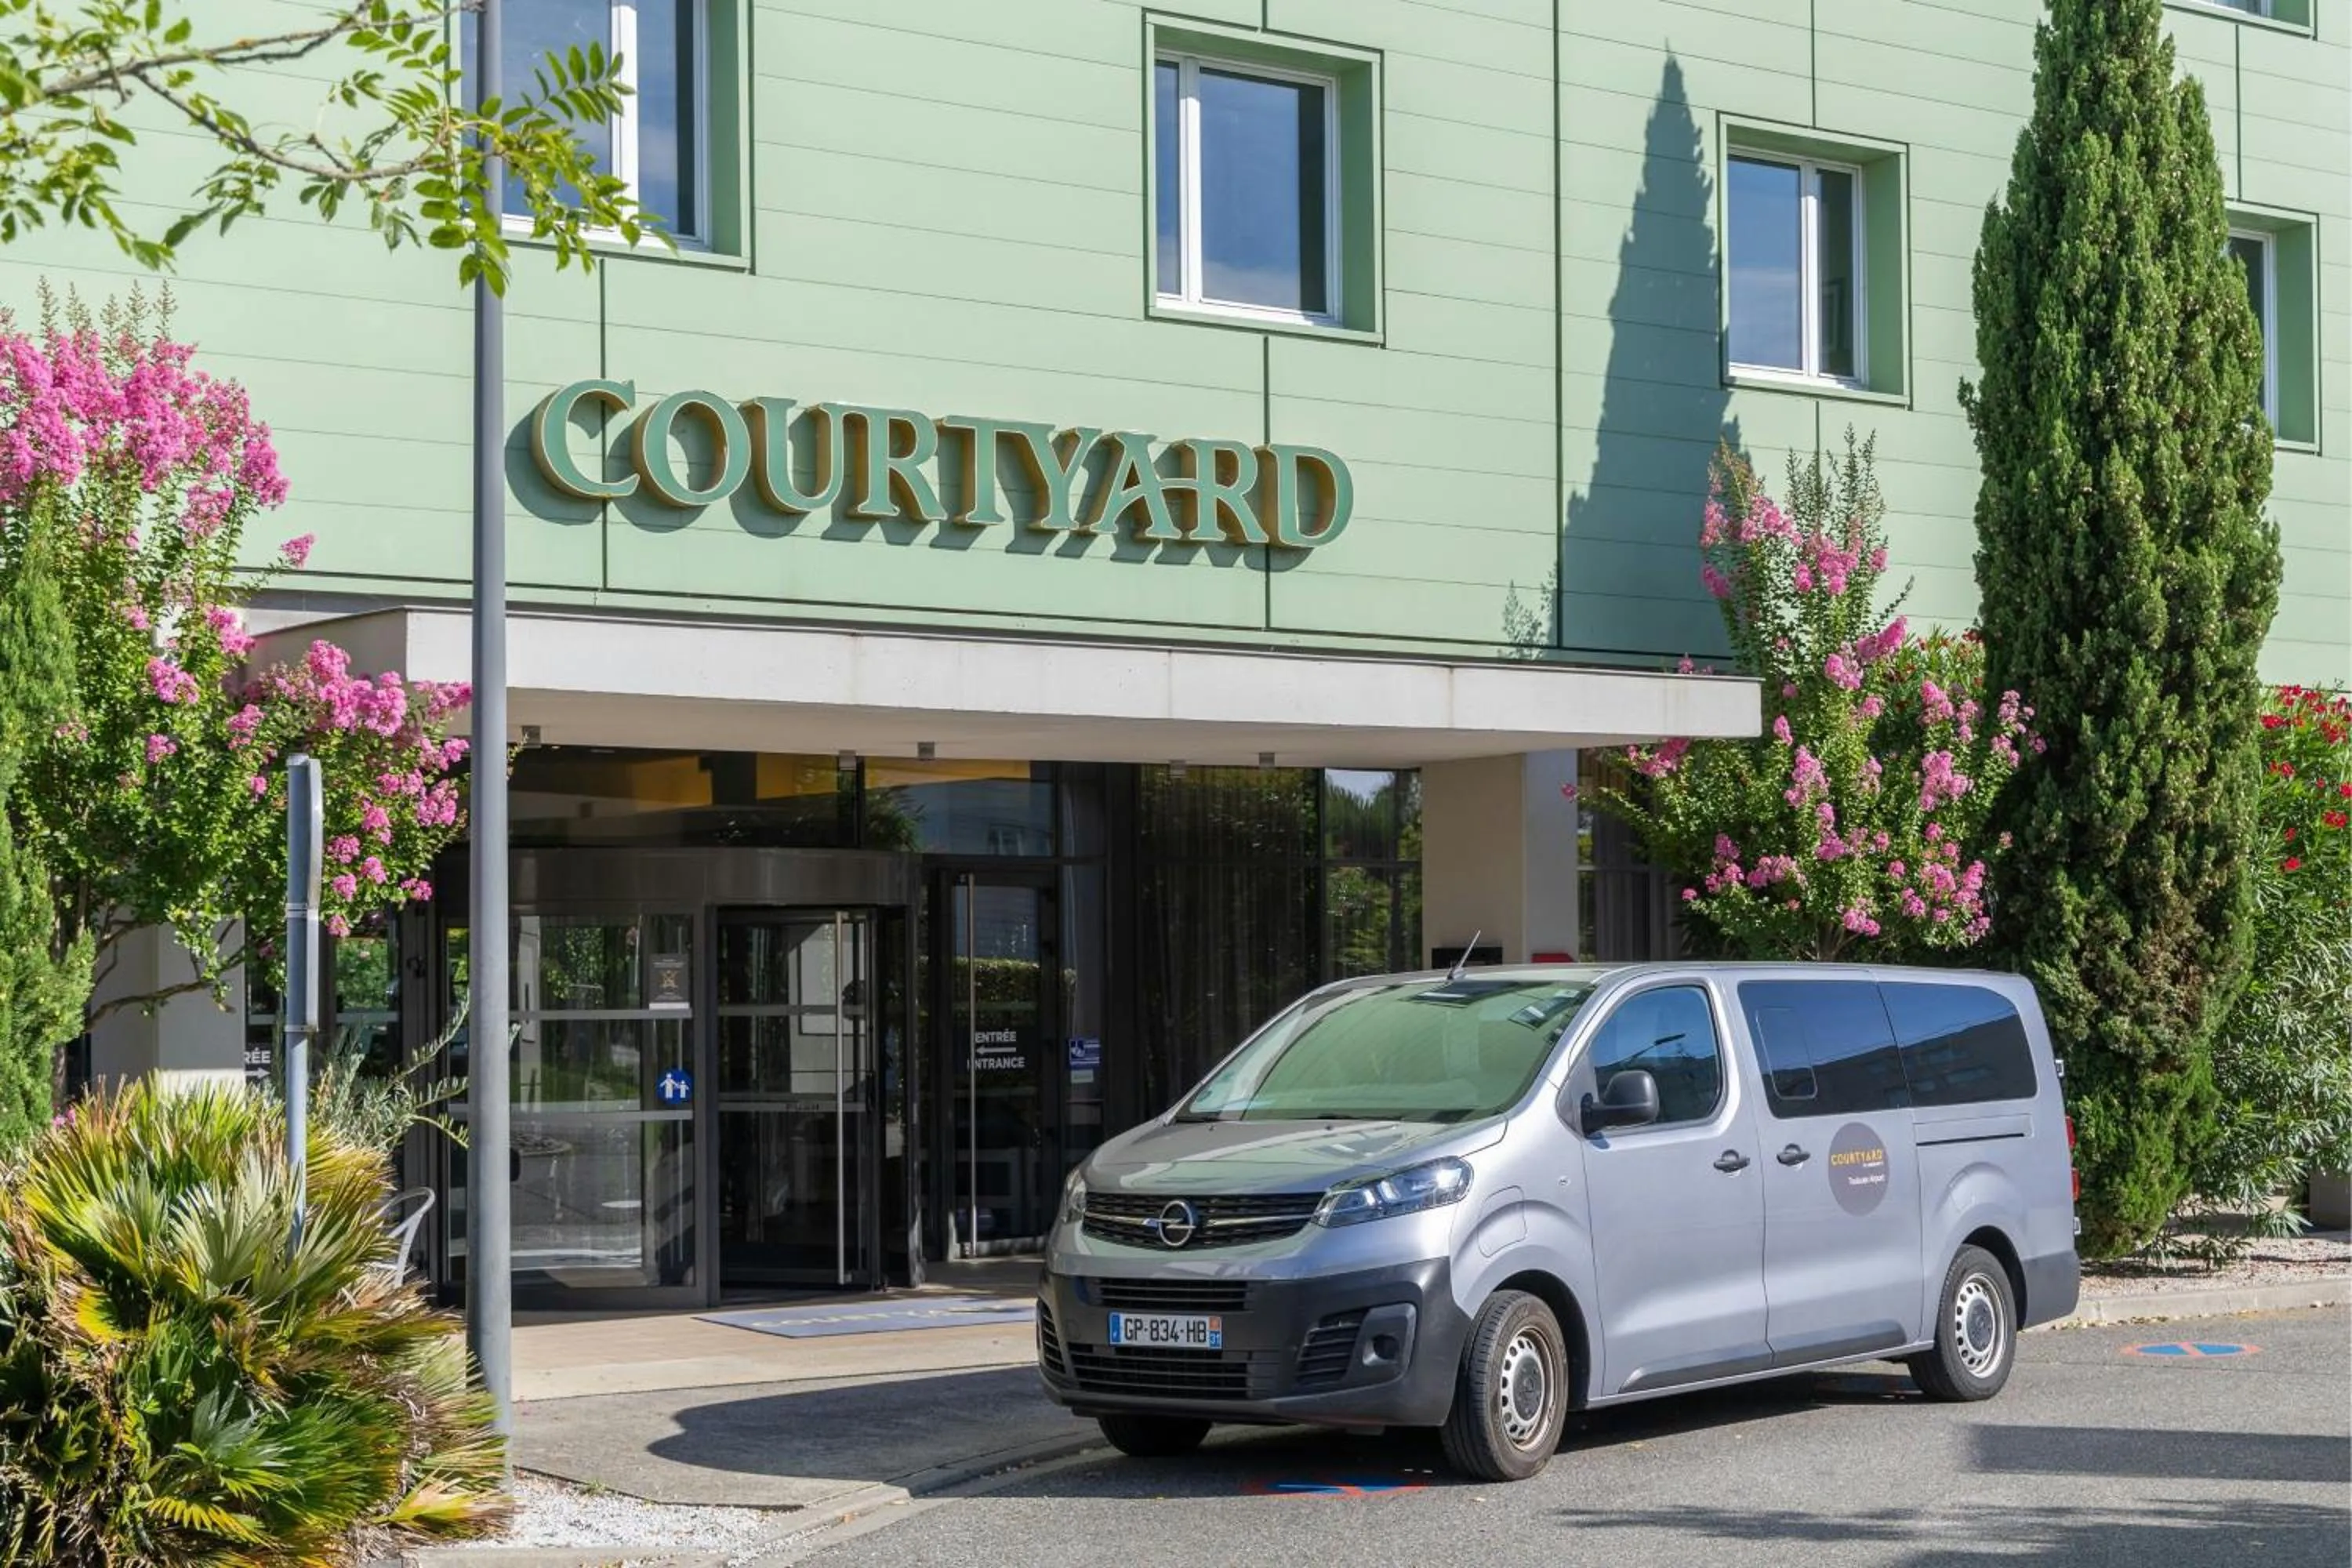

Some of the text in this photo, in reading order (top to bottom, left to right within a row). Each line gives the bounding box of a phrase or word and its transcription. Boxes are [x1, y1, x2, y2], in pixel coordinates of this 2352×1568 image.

[536, 379, 1354, 549] COURTYARD
[975, 1029, 1017, 1043] ENTRÉE
[1831, 1149, 1883, 1166] COURTYARD
[1123, 1318, 1207, 1343] GP-834-HB
